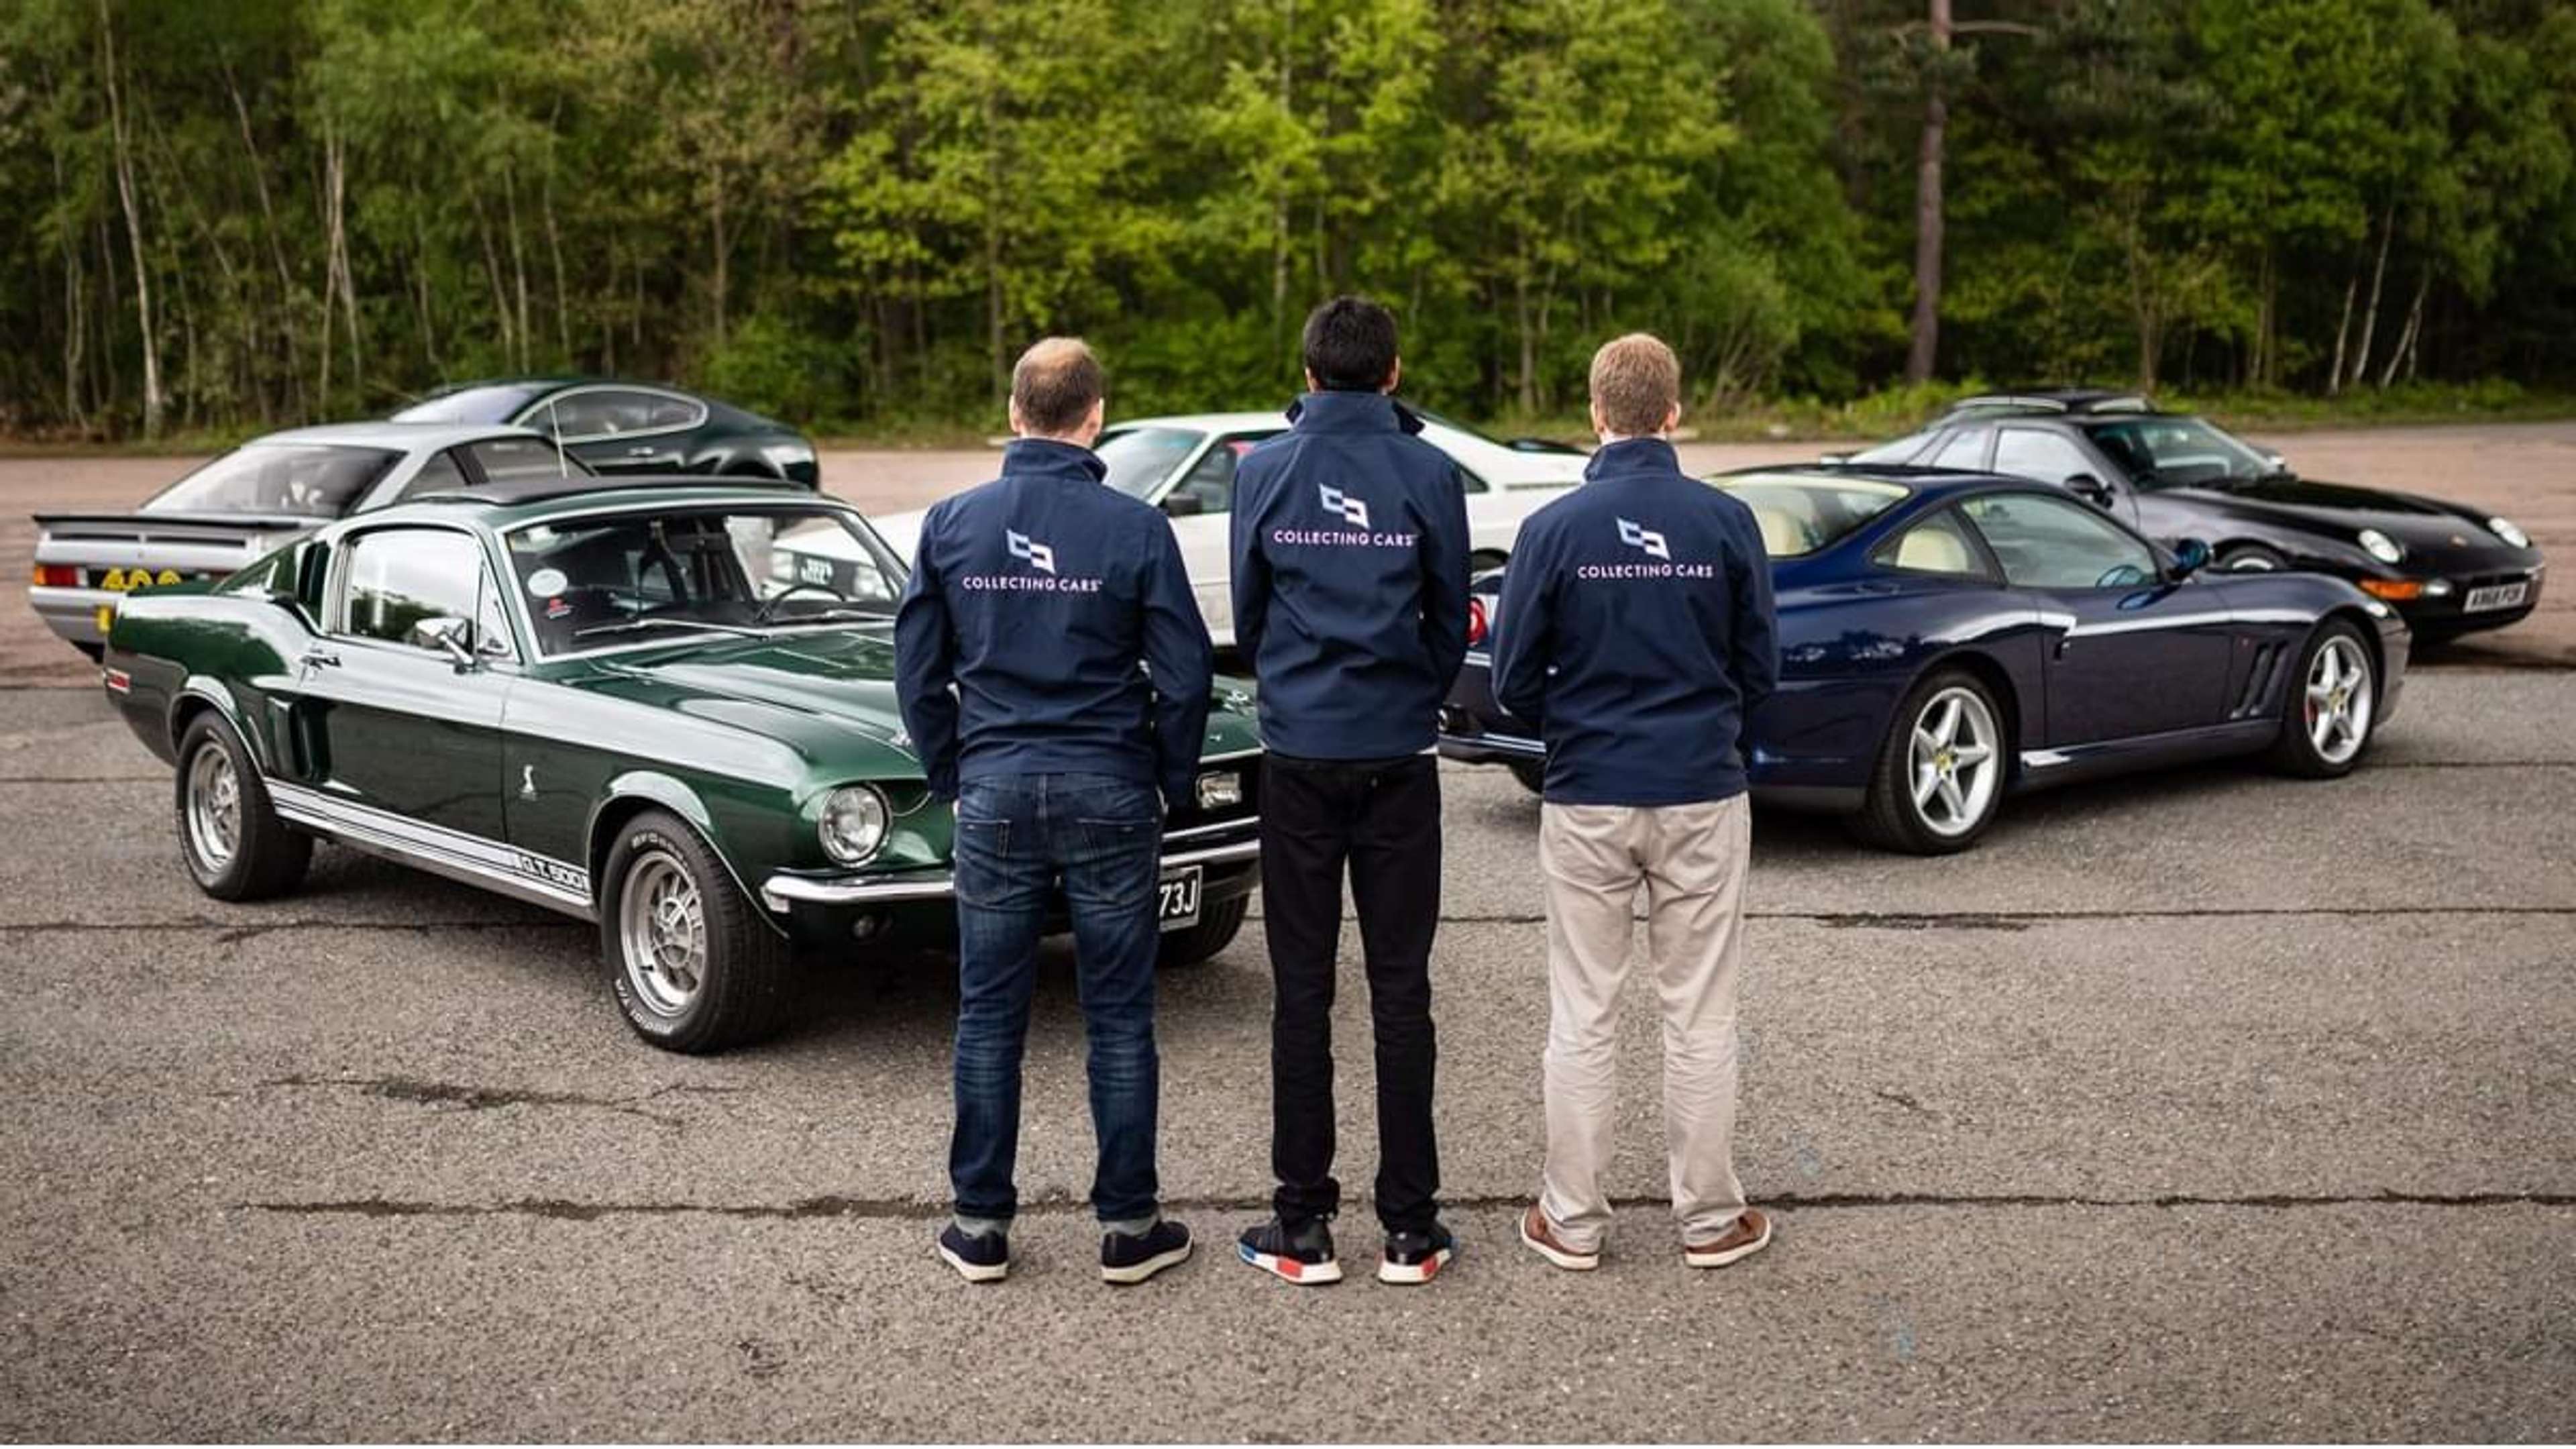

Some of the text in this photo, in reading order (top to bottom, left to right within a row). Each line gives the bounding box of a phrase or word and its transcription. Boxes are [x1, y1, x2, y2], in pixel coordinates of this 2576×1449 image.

[1273, 530, 1413, 547] COLLECTING CARS
[1576, 564, 1713, 579] COLLECTING CARS
[962, 576, 1056, 590] COLLECTING
